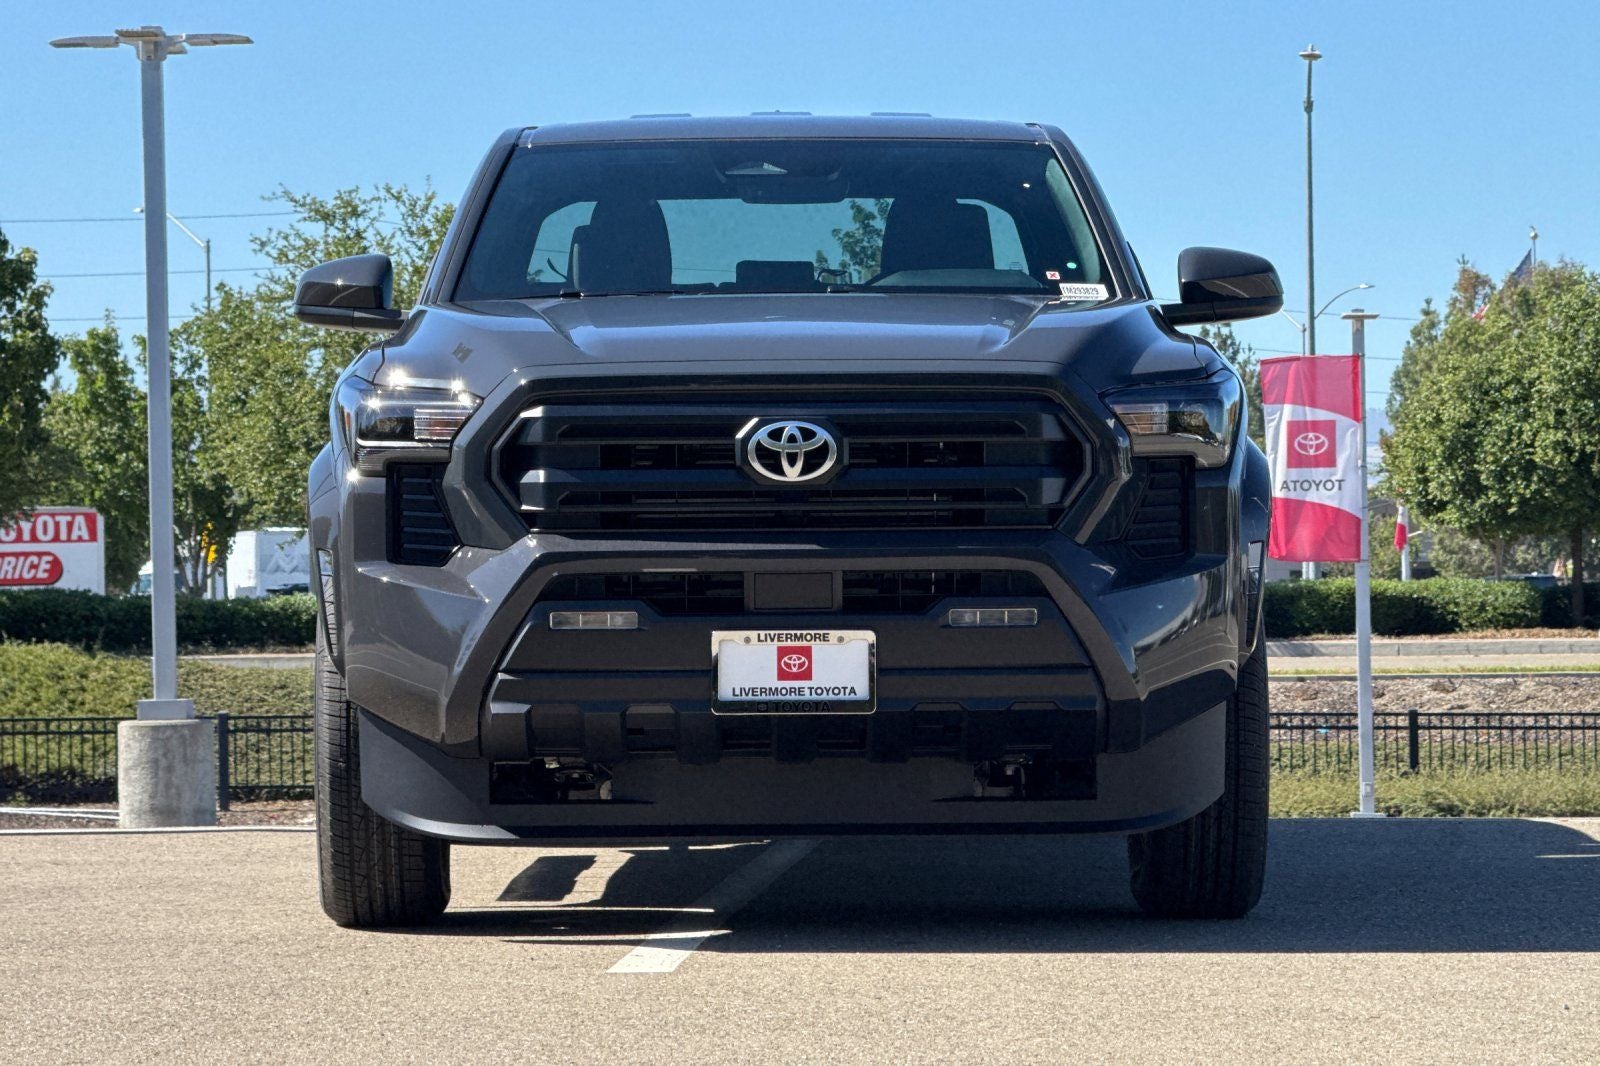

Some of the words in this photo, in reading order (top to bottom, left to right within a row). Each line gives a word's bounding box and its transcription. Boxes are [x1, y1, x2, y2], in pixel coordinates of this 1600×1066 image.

[0, 556, 54, 580] RICE
[757, 633, 830, 643] LIVERMORE
[732, 687, 805, 697] LIVERMORE
[807, 686, 857, 696] TOYOTA
[773, 701, 831, 712] TOYOTA
